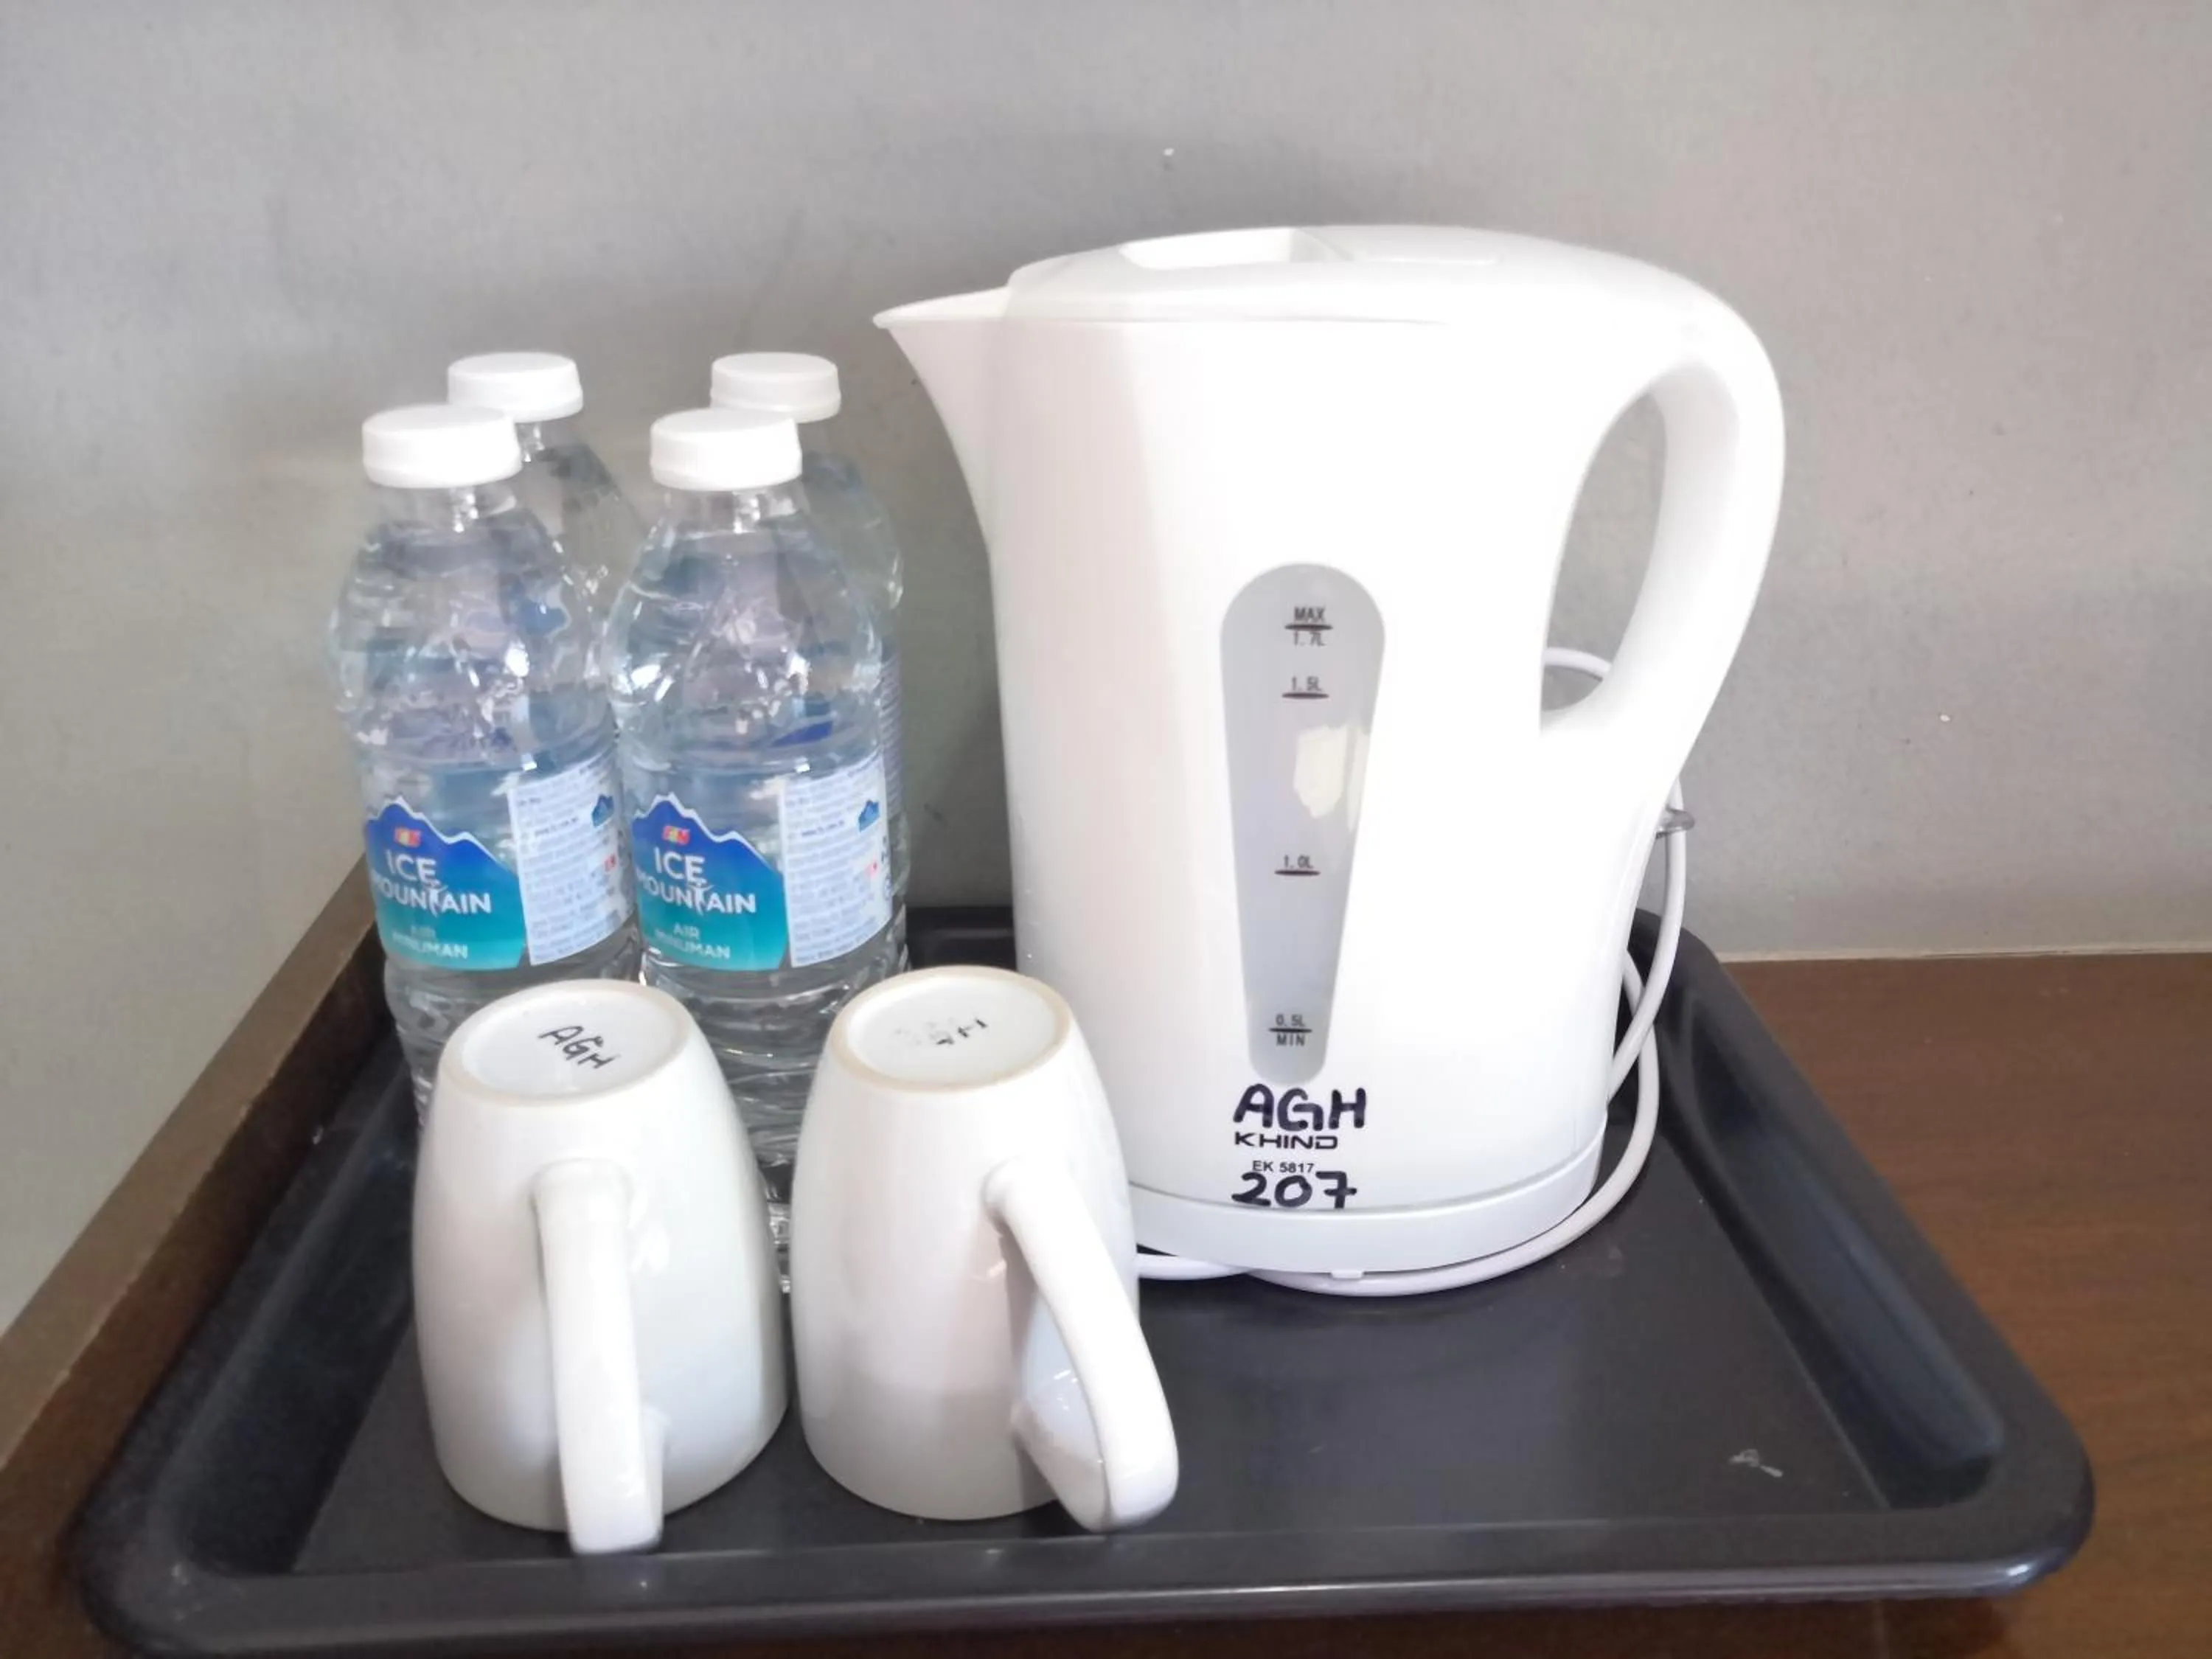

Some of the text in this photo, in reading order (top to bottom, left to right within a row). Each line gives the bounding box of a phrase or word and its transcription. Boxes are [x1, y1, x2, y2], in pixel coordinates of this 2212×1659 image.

[1294, 606, 1326, 622] MAX
[1291, 675, 1322, 692] 1.5L
[384, 849, 441, 886] ICE
[654, 846, 708, 885] ICE
[673, 922, 700, 940] AIR
[392, 930, 469, 959] UMAN
[654, 928, 731, 959] UMAN
[1275, 1013, 1307, 1027] 0.5L
[538, 1026, 622, 1069] AGH
[1276, 1032, 1305, 1046] MIN
[1232, 1082, 1367, 1132] AGH
[1234, 1131, 1338, 1150] KHIND
[1251, 1161, 1315, 1173] EK 5817
[1231, 1171, 1358, 1209] 207
